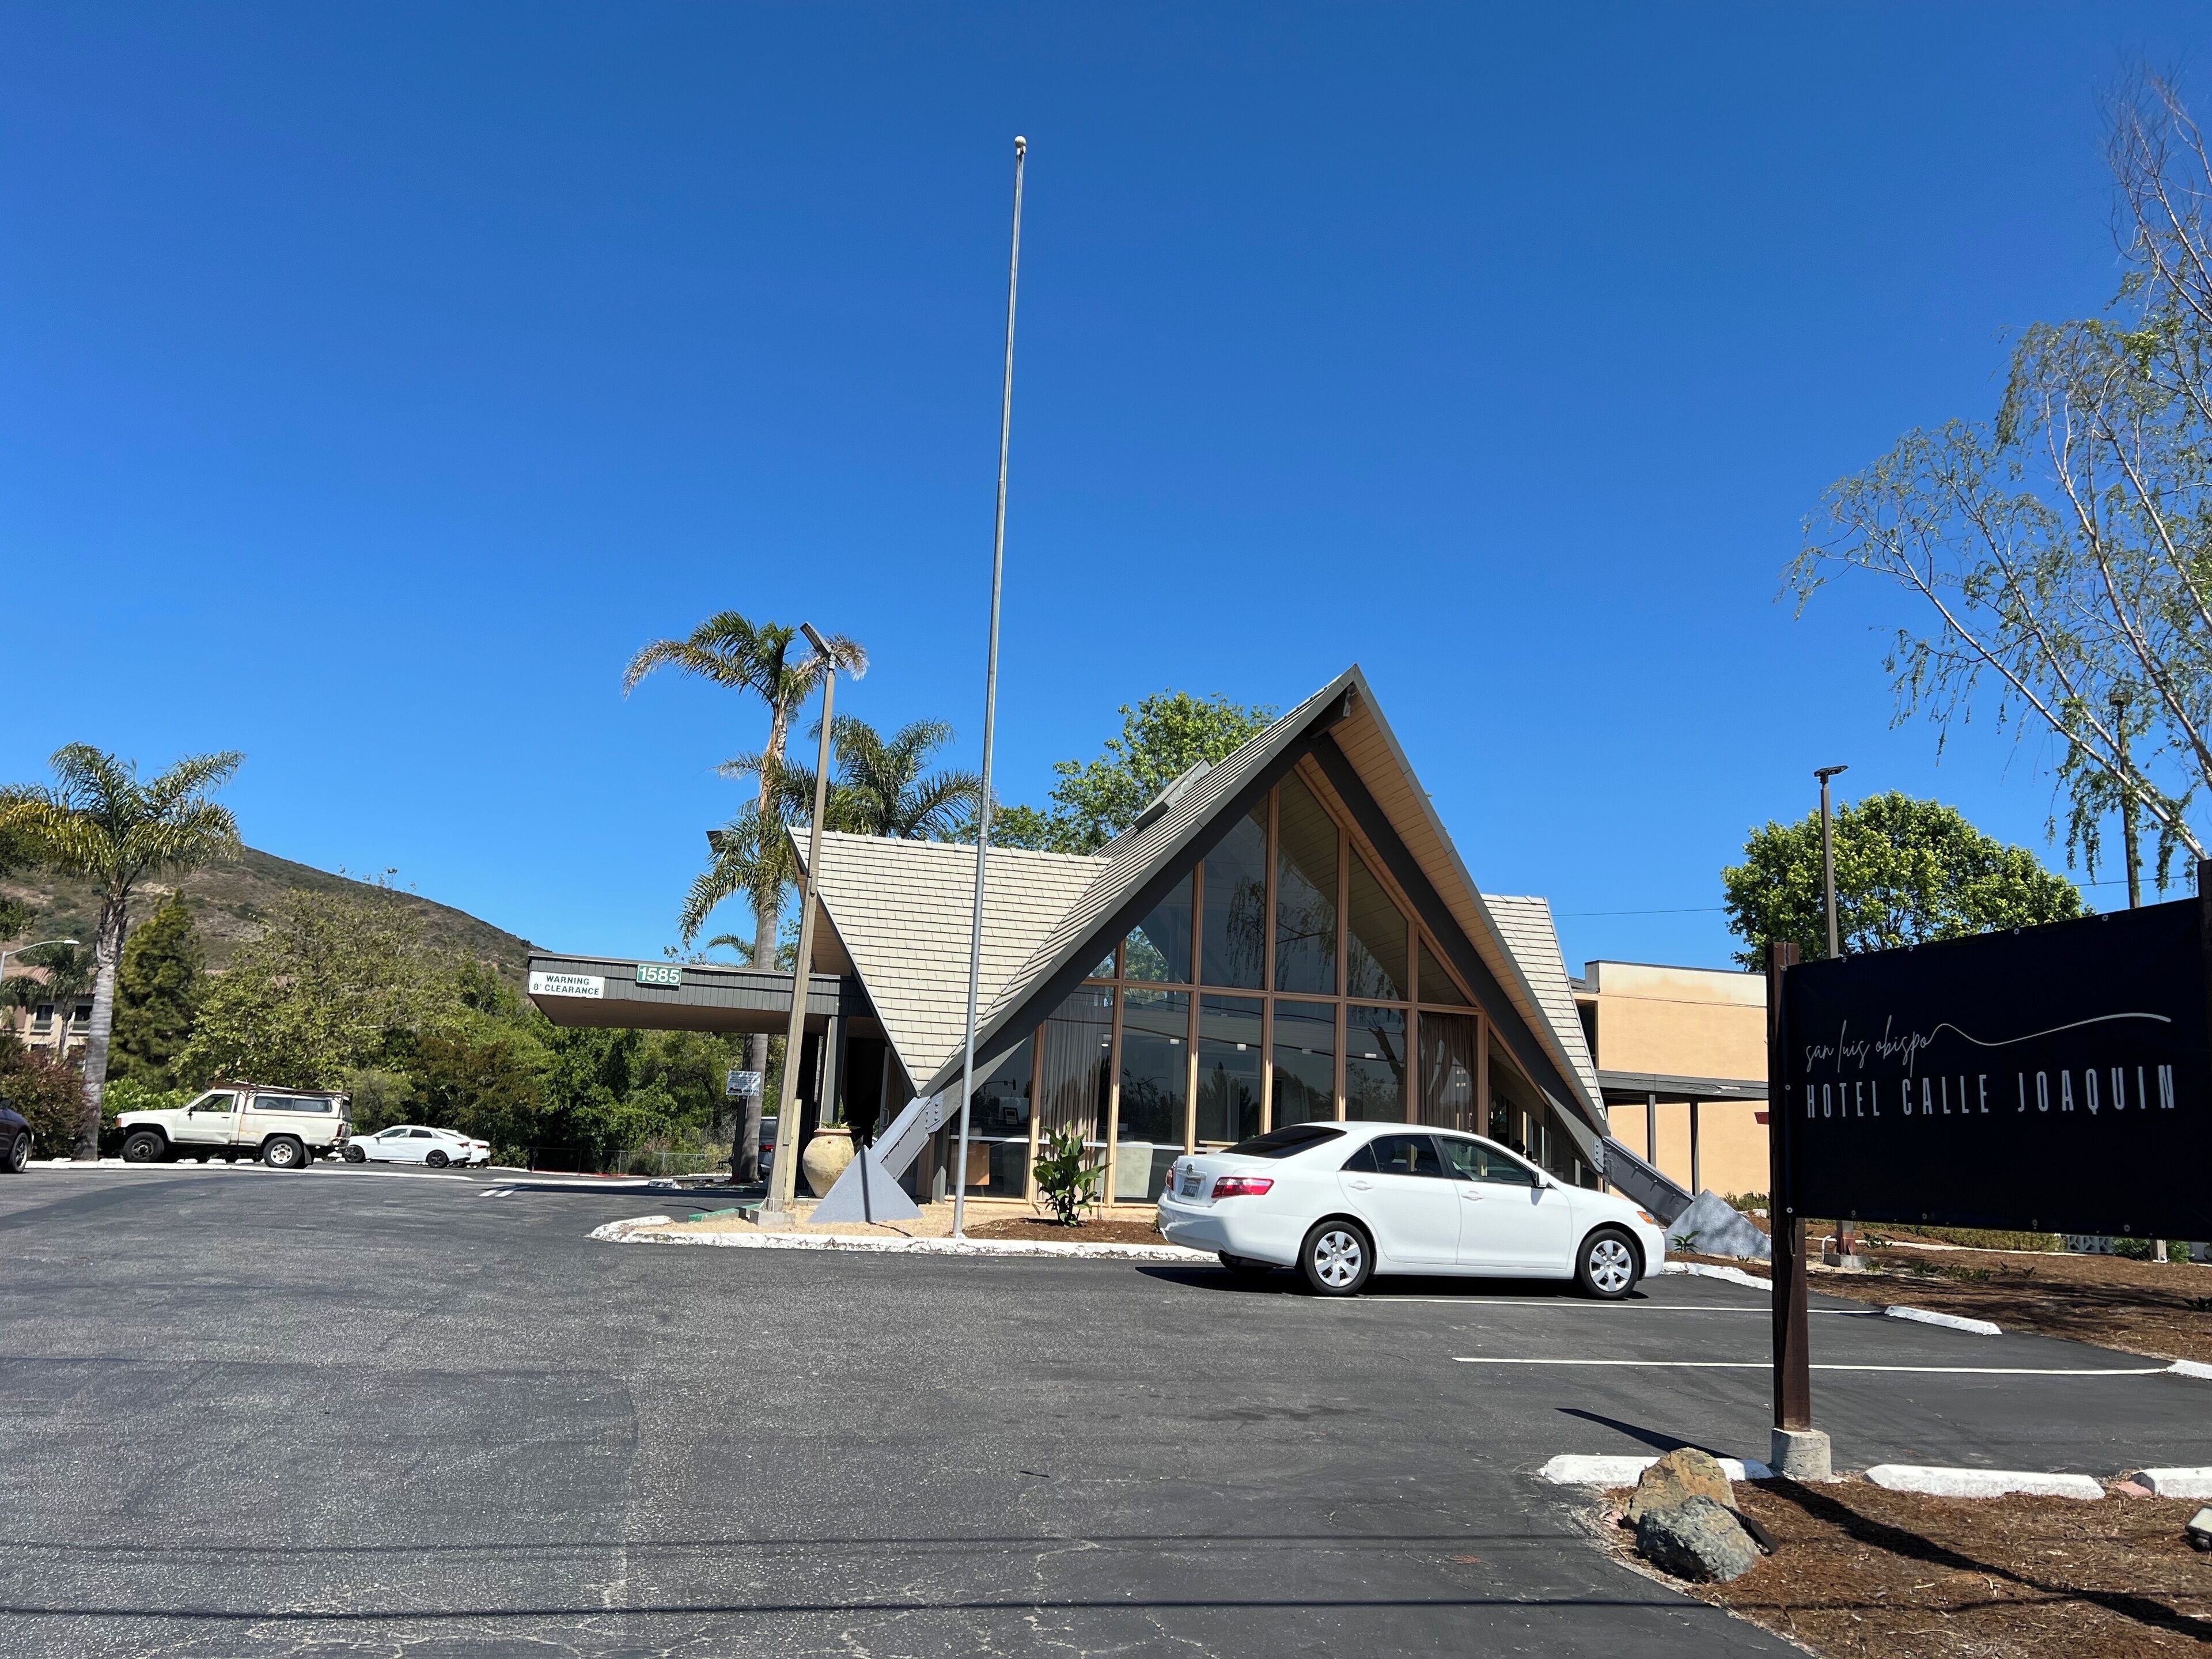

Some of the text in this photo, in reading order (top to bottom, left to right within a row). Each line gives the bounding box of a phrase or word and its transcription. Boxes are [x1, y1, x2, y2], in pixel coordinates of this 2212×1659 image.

[546, 975, 589, 985] WARNING
[639, 967, 680, 983] 1585
[533, 983, 600, 995] 8' CLEARANCE
[1806, 1015, 1931, 1078] san luis obispo
[1806, 1065, 2175, 1118] HOTEL CALLE JOAQUIN
